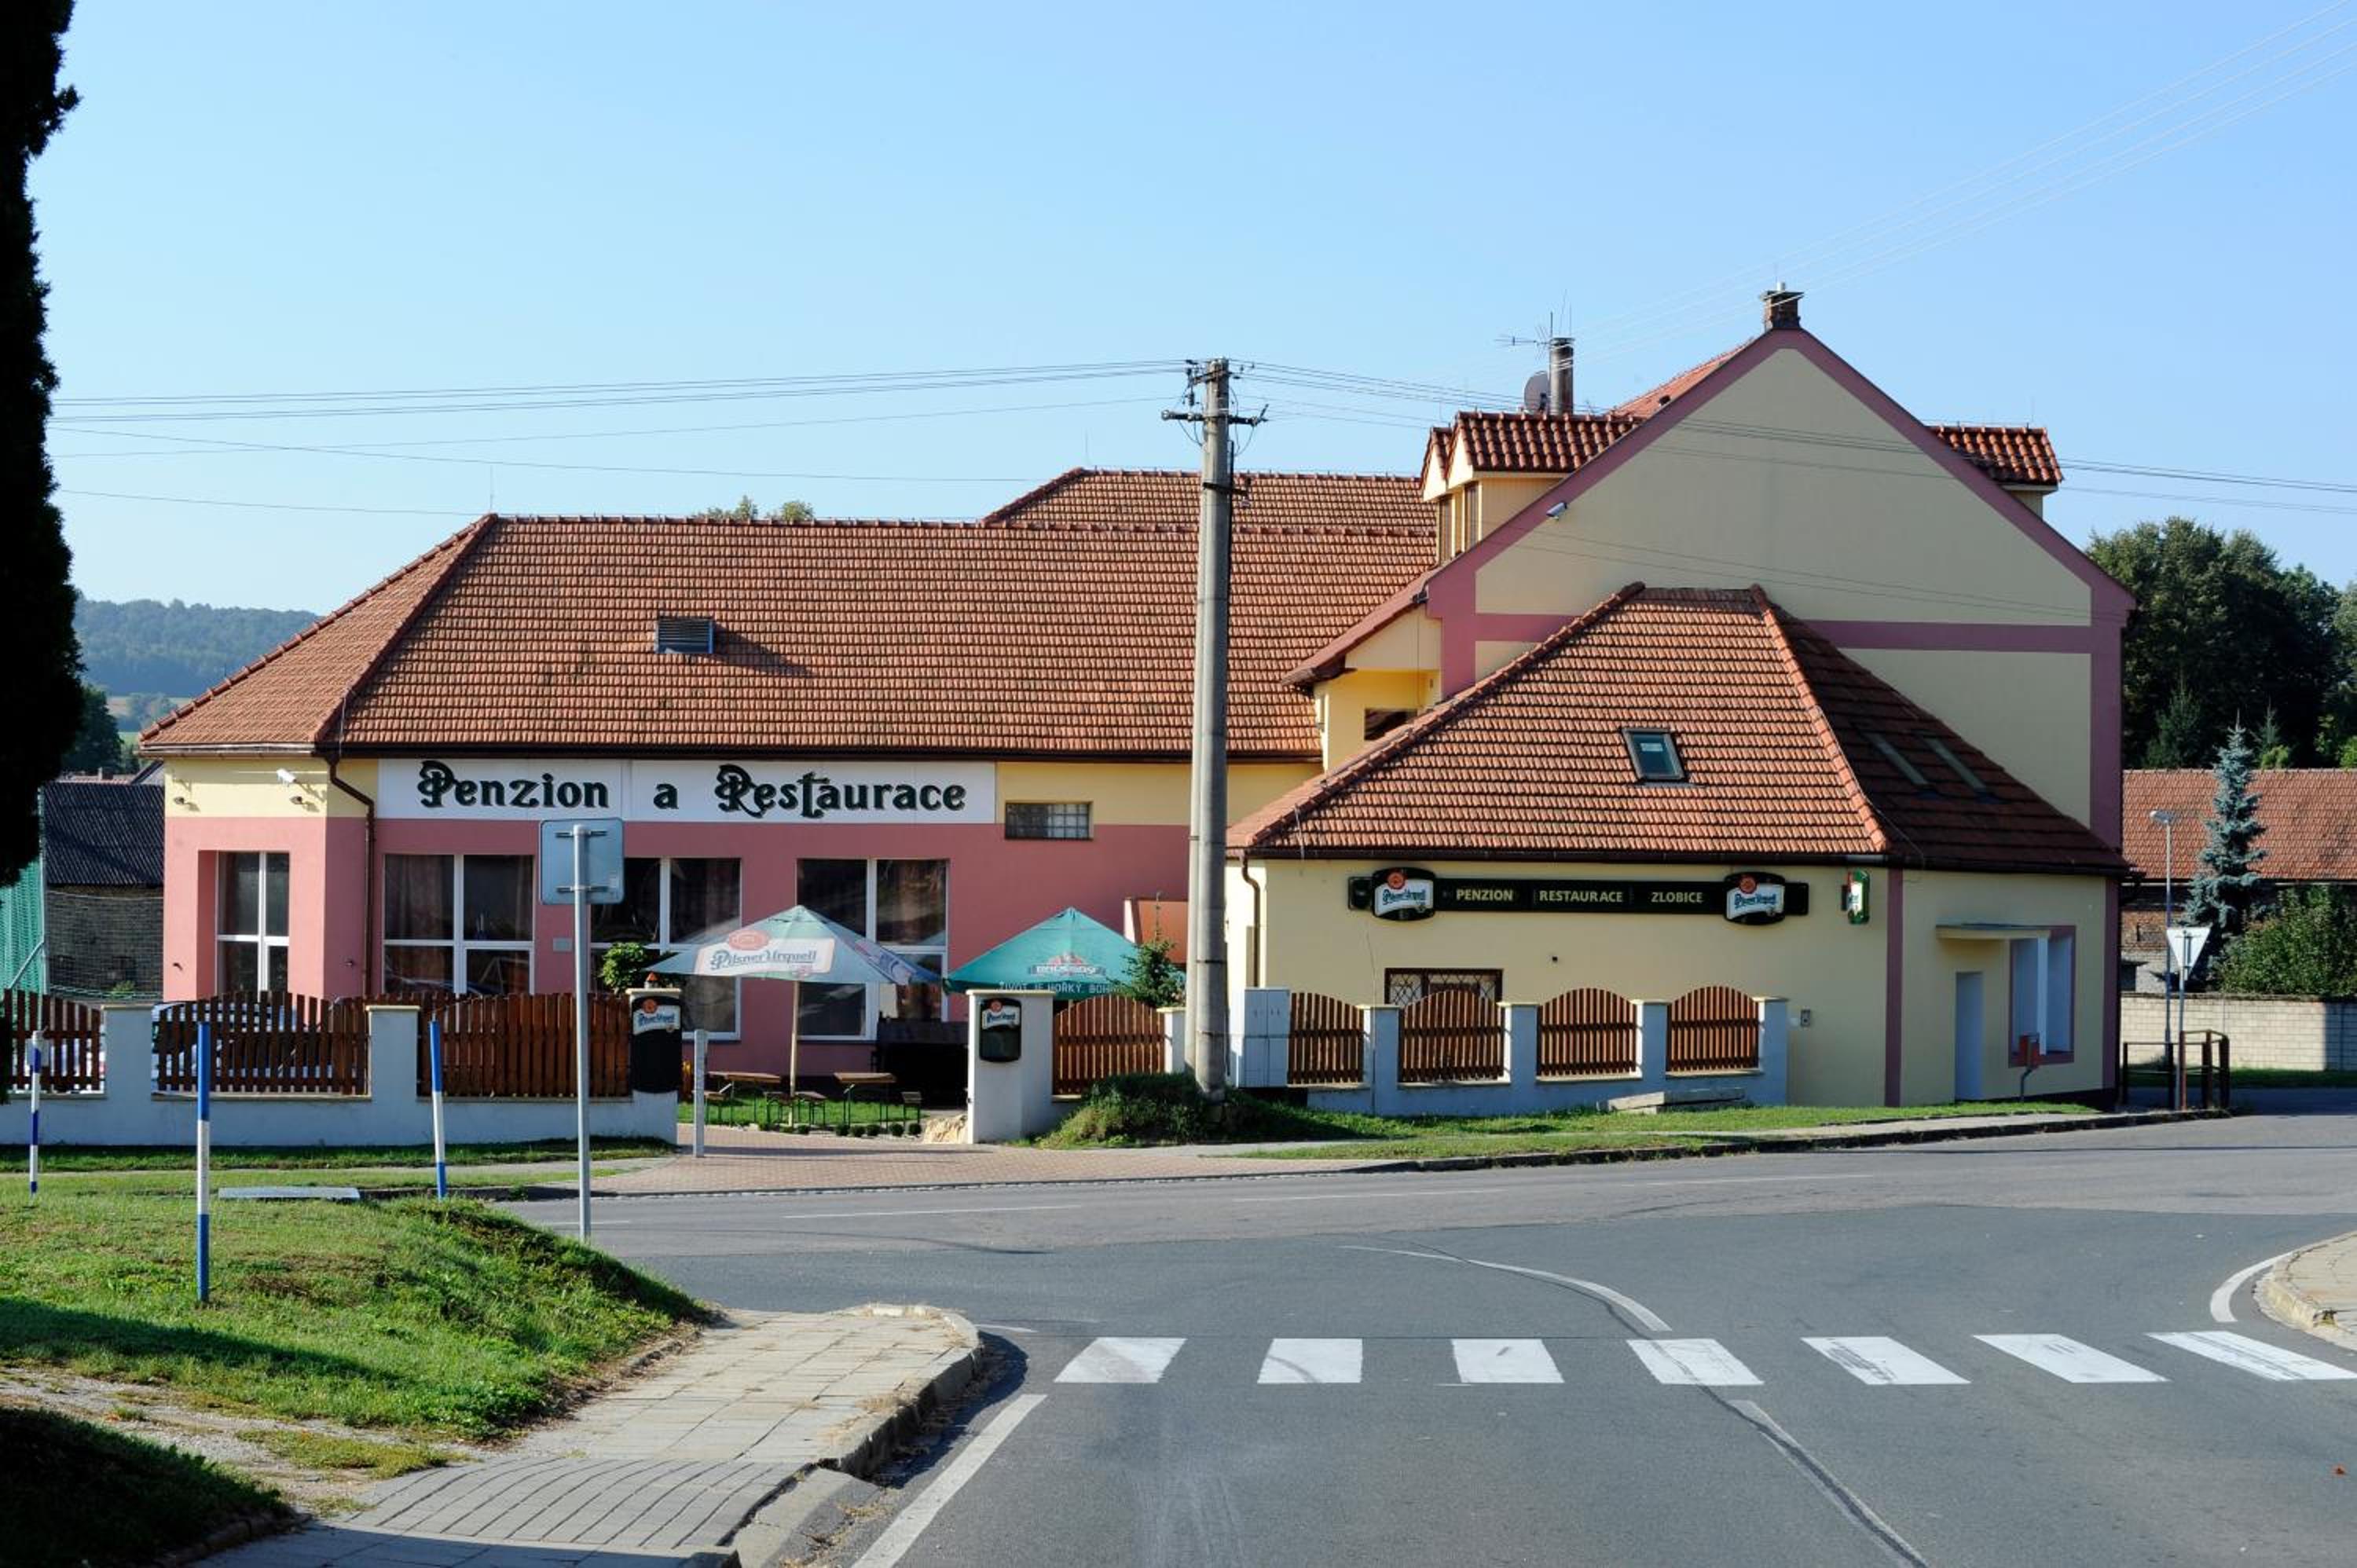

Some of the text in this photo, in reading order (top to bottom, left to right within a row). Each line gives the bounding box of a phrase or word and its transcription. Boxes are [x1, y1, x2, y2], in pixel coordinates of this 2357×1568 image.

[416, 760, 967, 819] Penzion a Restaurace
[1456, 888, 1703, 903] PENZION RESTAURACE ZLOBICE
